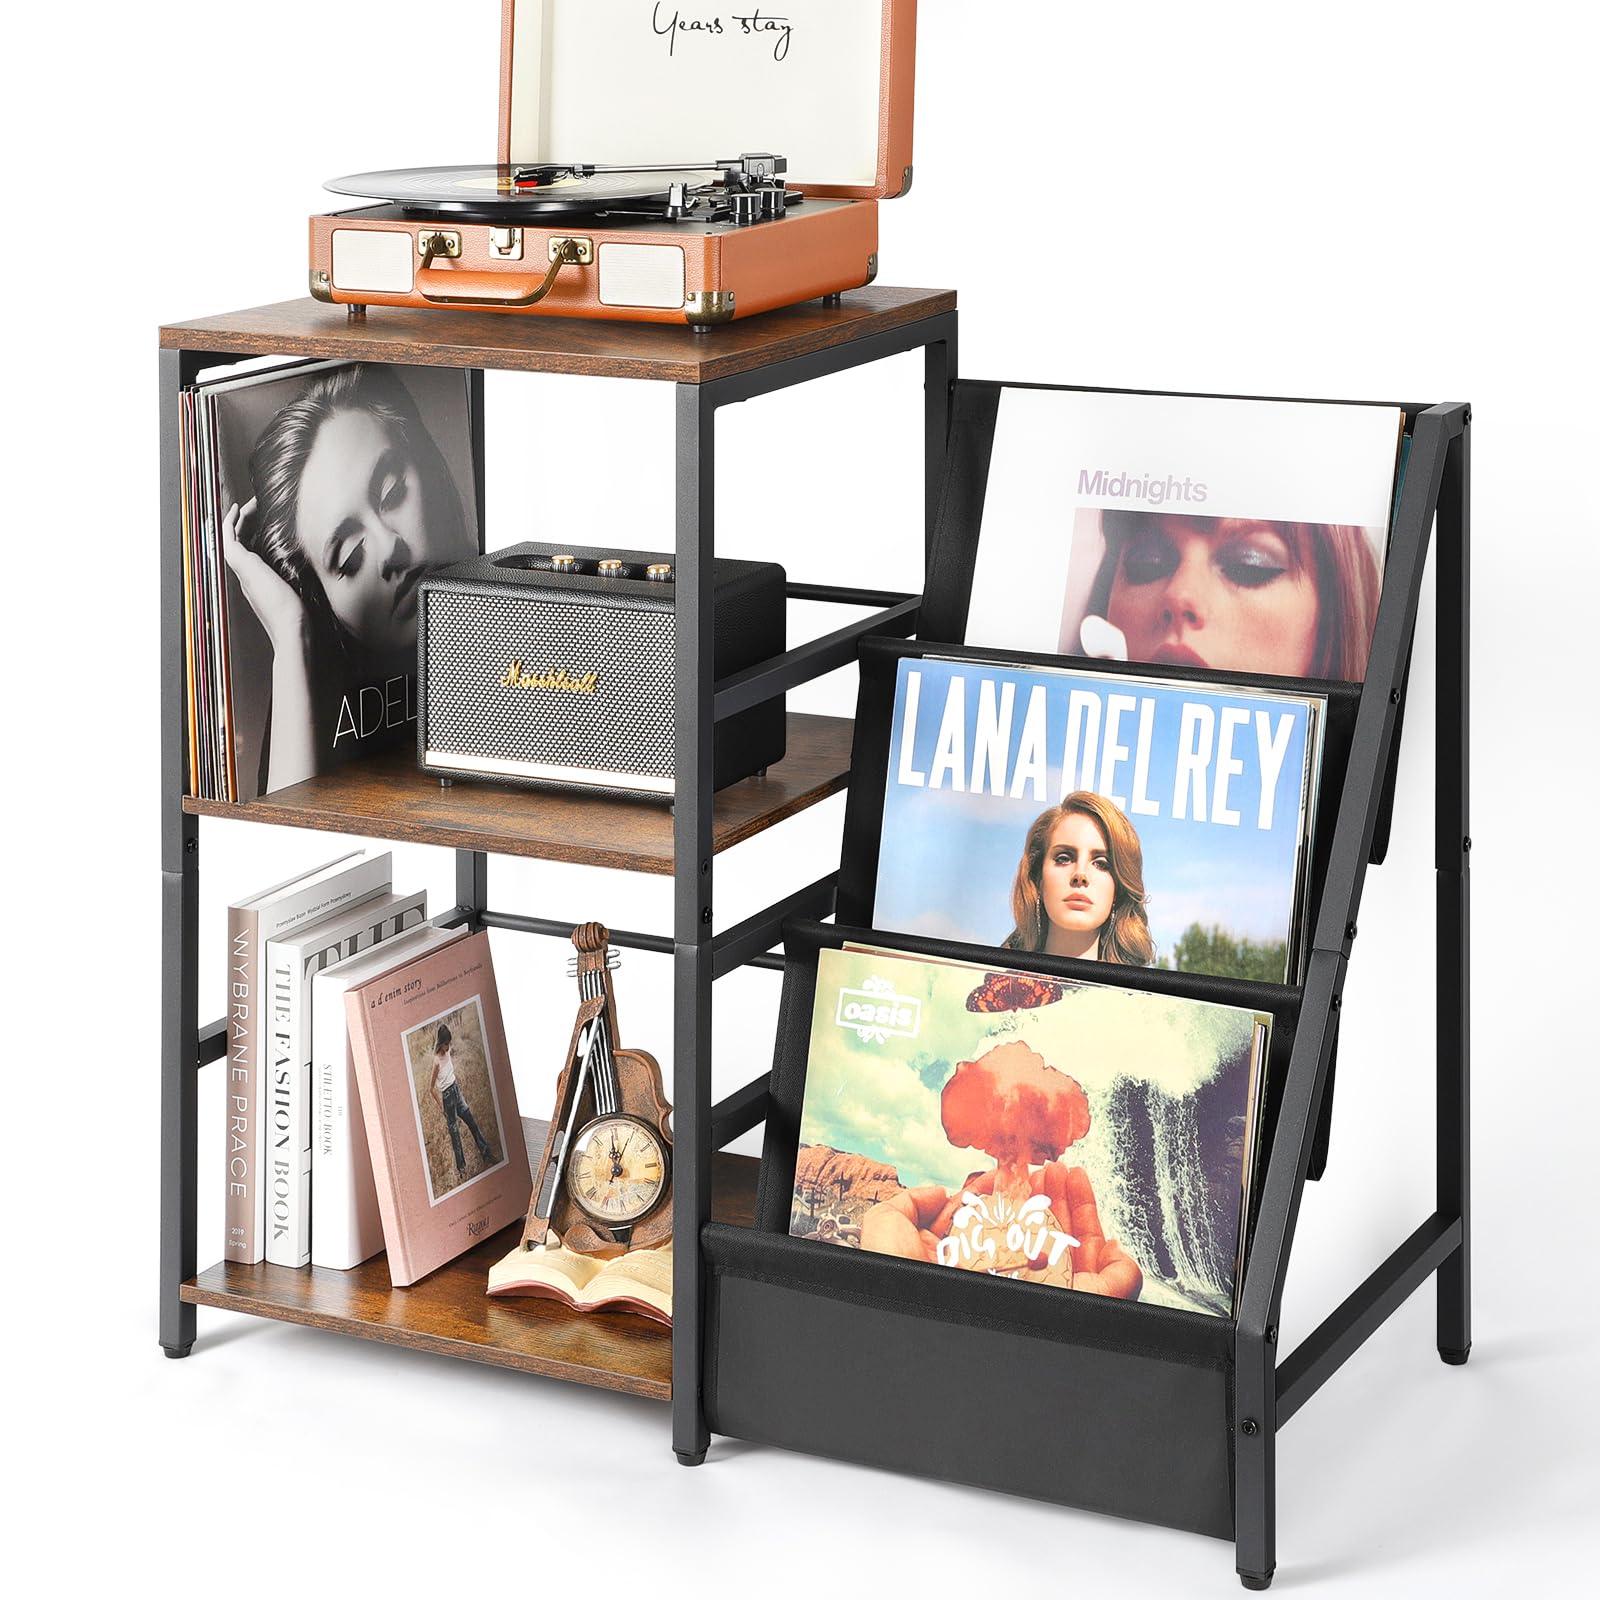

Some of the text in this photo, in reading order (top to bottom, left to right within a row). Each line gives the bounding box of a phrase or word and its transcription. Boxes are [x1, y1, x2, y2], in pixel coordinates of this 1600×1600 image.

[653, 1, 794, 61] Years stay
[1077, 469, 1208, 505] Midnights
[500, 660, 597, 692] Marshall
[897, 671, 1296, 830] LANA DEL REY
[404, 978, 423, 993] story
[844, 1001, 914, 1027] oasis
[230, 928, 249, 1198] WYBRANE PRACE
[273, 963, 291, 1241] THE FASHION BOOK
[323, 1124, 333, 1156] BOOK
[936, 1223, 1081, 1267] DIG OUT
